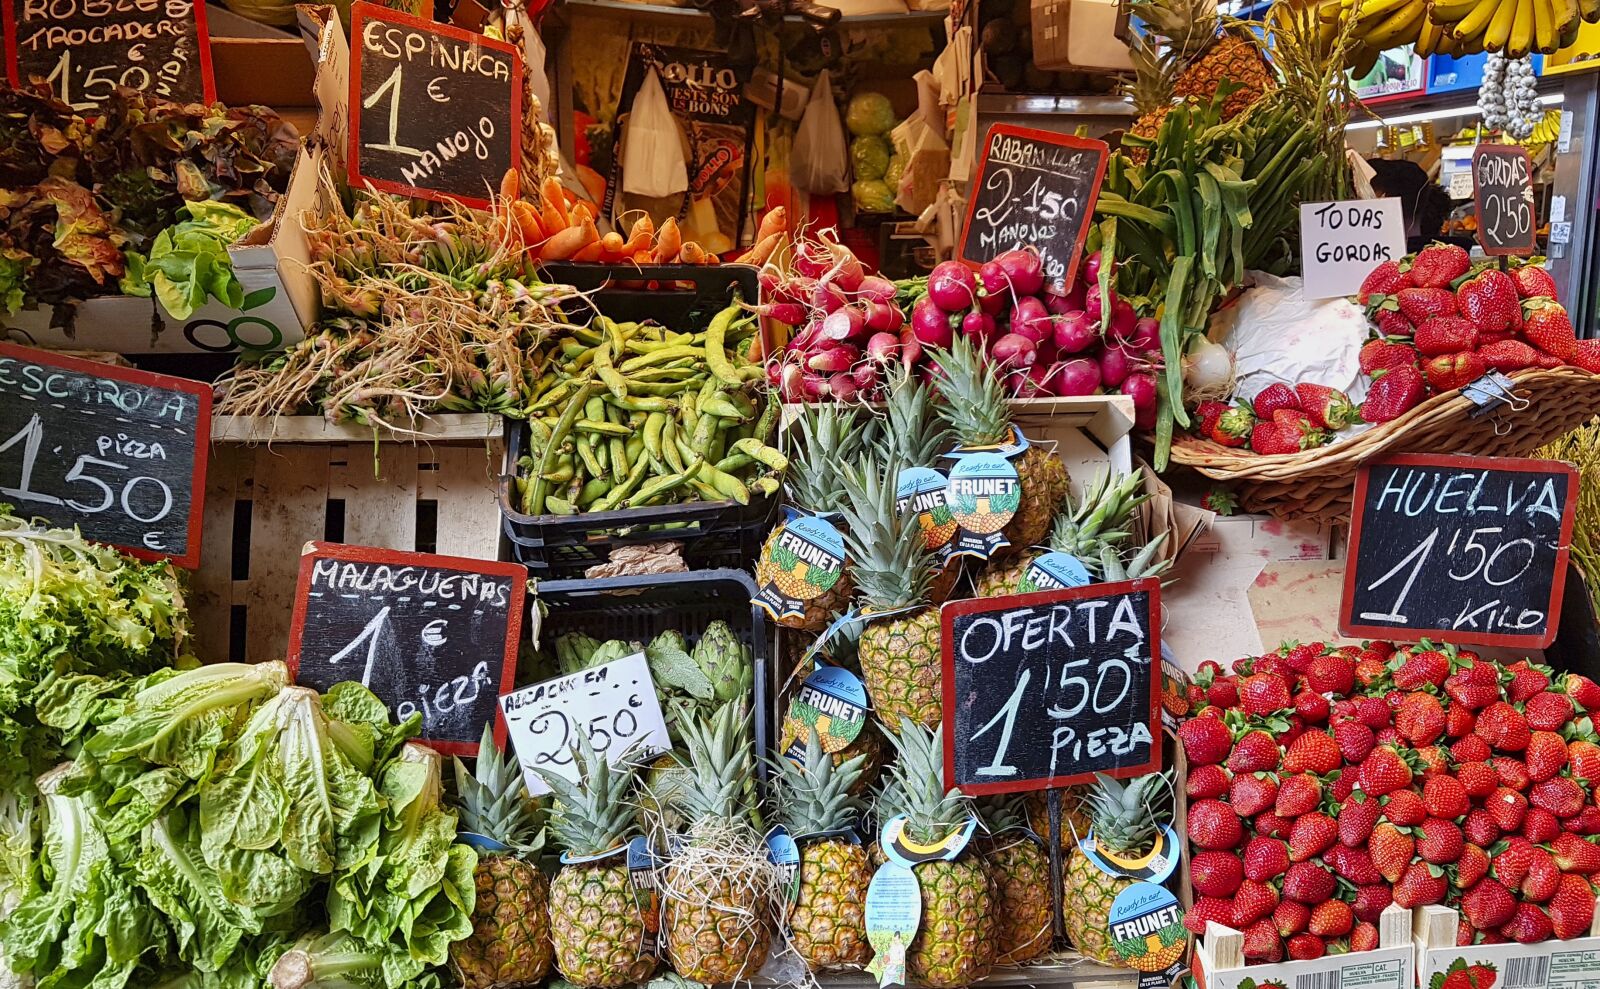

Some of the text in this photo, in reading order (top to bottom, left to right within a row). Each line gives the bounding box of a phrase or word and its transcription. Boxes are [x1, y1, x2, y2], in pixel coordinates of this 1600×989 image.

[127, 43, 147, 61] €
[363, 63, 451, 157] 1 €
[688, 101, 730, 117] BONS
[400, 116, 495, 188] MANOJO
[989, 133, 1083, 168] RABANLLA
[1485, 193, 1531, 246] 2'50
[1315, 242, 1392, 264] GORDAS
[950, 479, 1016, 496] FRUNET
[1375, 467, 1561, 522] HUELVA
[142, 531, 166, 550] €
[778, 531, 841, 574] FRUNET
[960, 594, 1145, 664] OFERTA
[1452, 598, 1544, 630] KILO
[329, 605, 449, 688] 1 €
[628, 694, 643, 708] €
[799, 686, 863, 725] FRUNET
[1050, 722, 1153, 770] PIEZA
[1113, 904, 1179, 943] FRUNET
